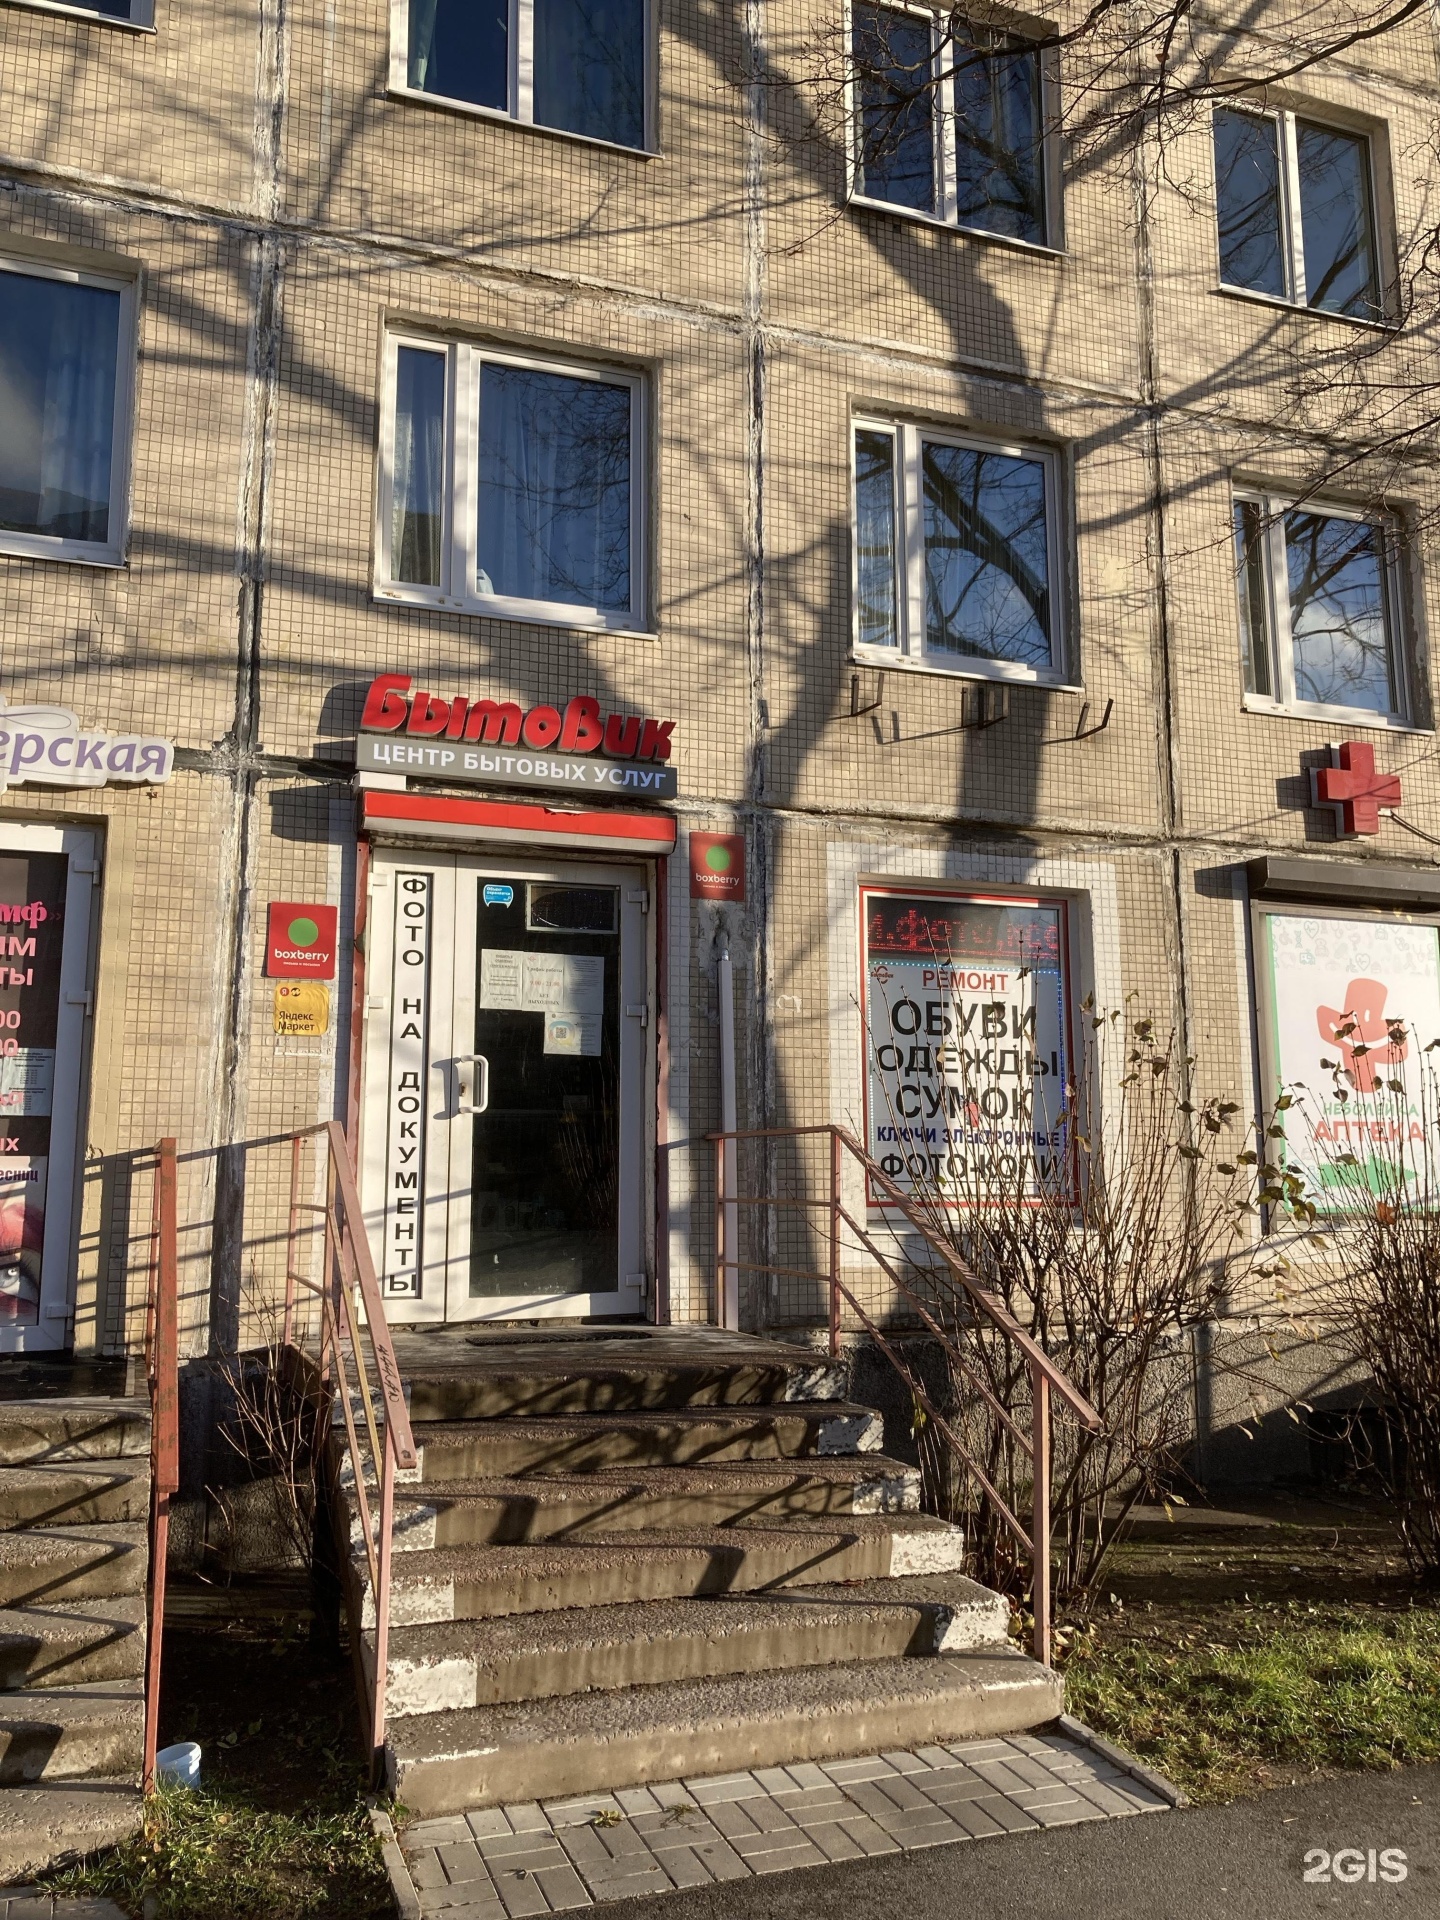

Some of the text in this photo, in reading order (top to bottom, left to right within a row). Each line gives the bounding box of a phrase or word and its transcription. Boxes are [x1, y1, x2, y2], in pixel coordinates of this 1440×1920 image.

[361, 673, 677, 763] Бытовик
[373, 742, 667, 790] ЦЕНТР БЫТОВЫХ УСЛУГ
[695, 872, 740, 886] boxberry
[274, 948, 330, 963] boxberry
[922, 969, 1009, 991] РЕМОНТ
[278, 1021, 315, 1032] Маркет
[279, 1010, 314, 1021] Яндекс
[891, 999, 1037, 1040] ОБУВИ
[877, 1045, 1059, 1077] ОДЕЖДЫ
[388, 878, 427, 1292] ФОТО НА ДОКУМЕНТЫ
[896, 1084, 1035, 1120] СУМОК
[877, 1126, 1060, 1147] КЛЮЧИ ЭЛЕКТРОННЫЕ
[1313, 1120, 1425, 1142] АПТЕКА
